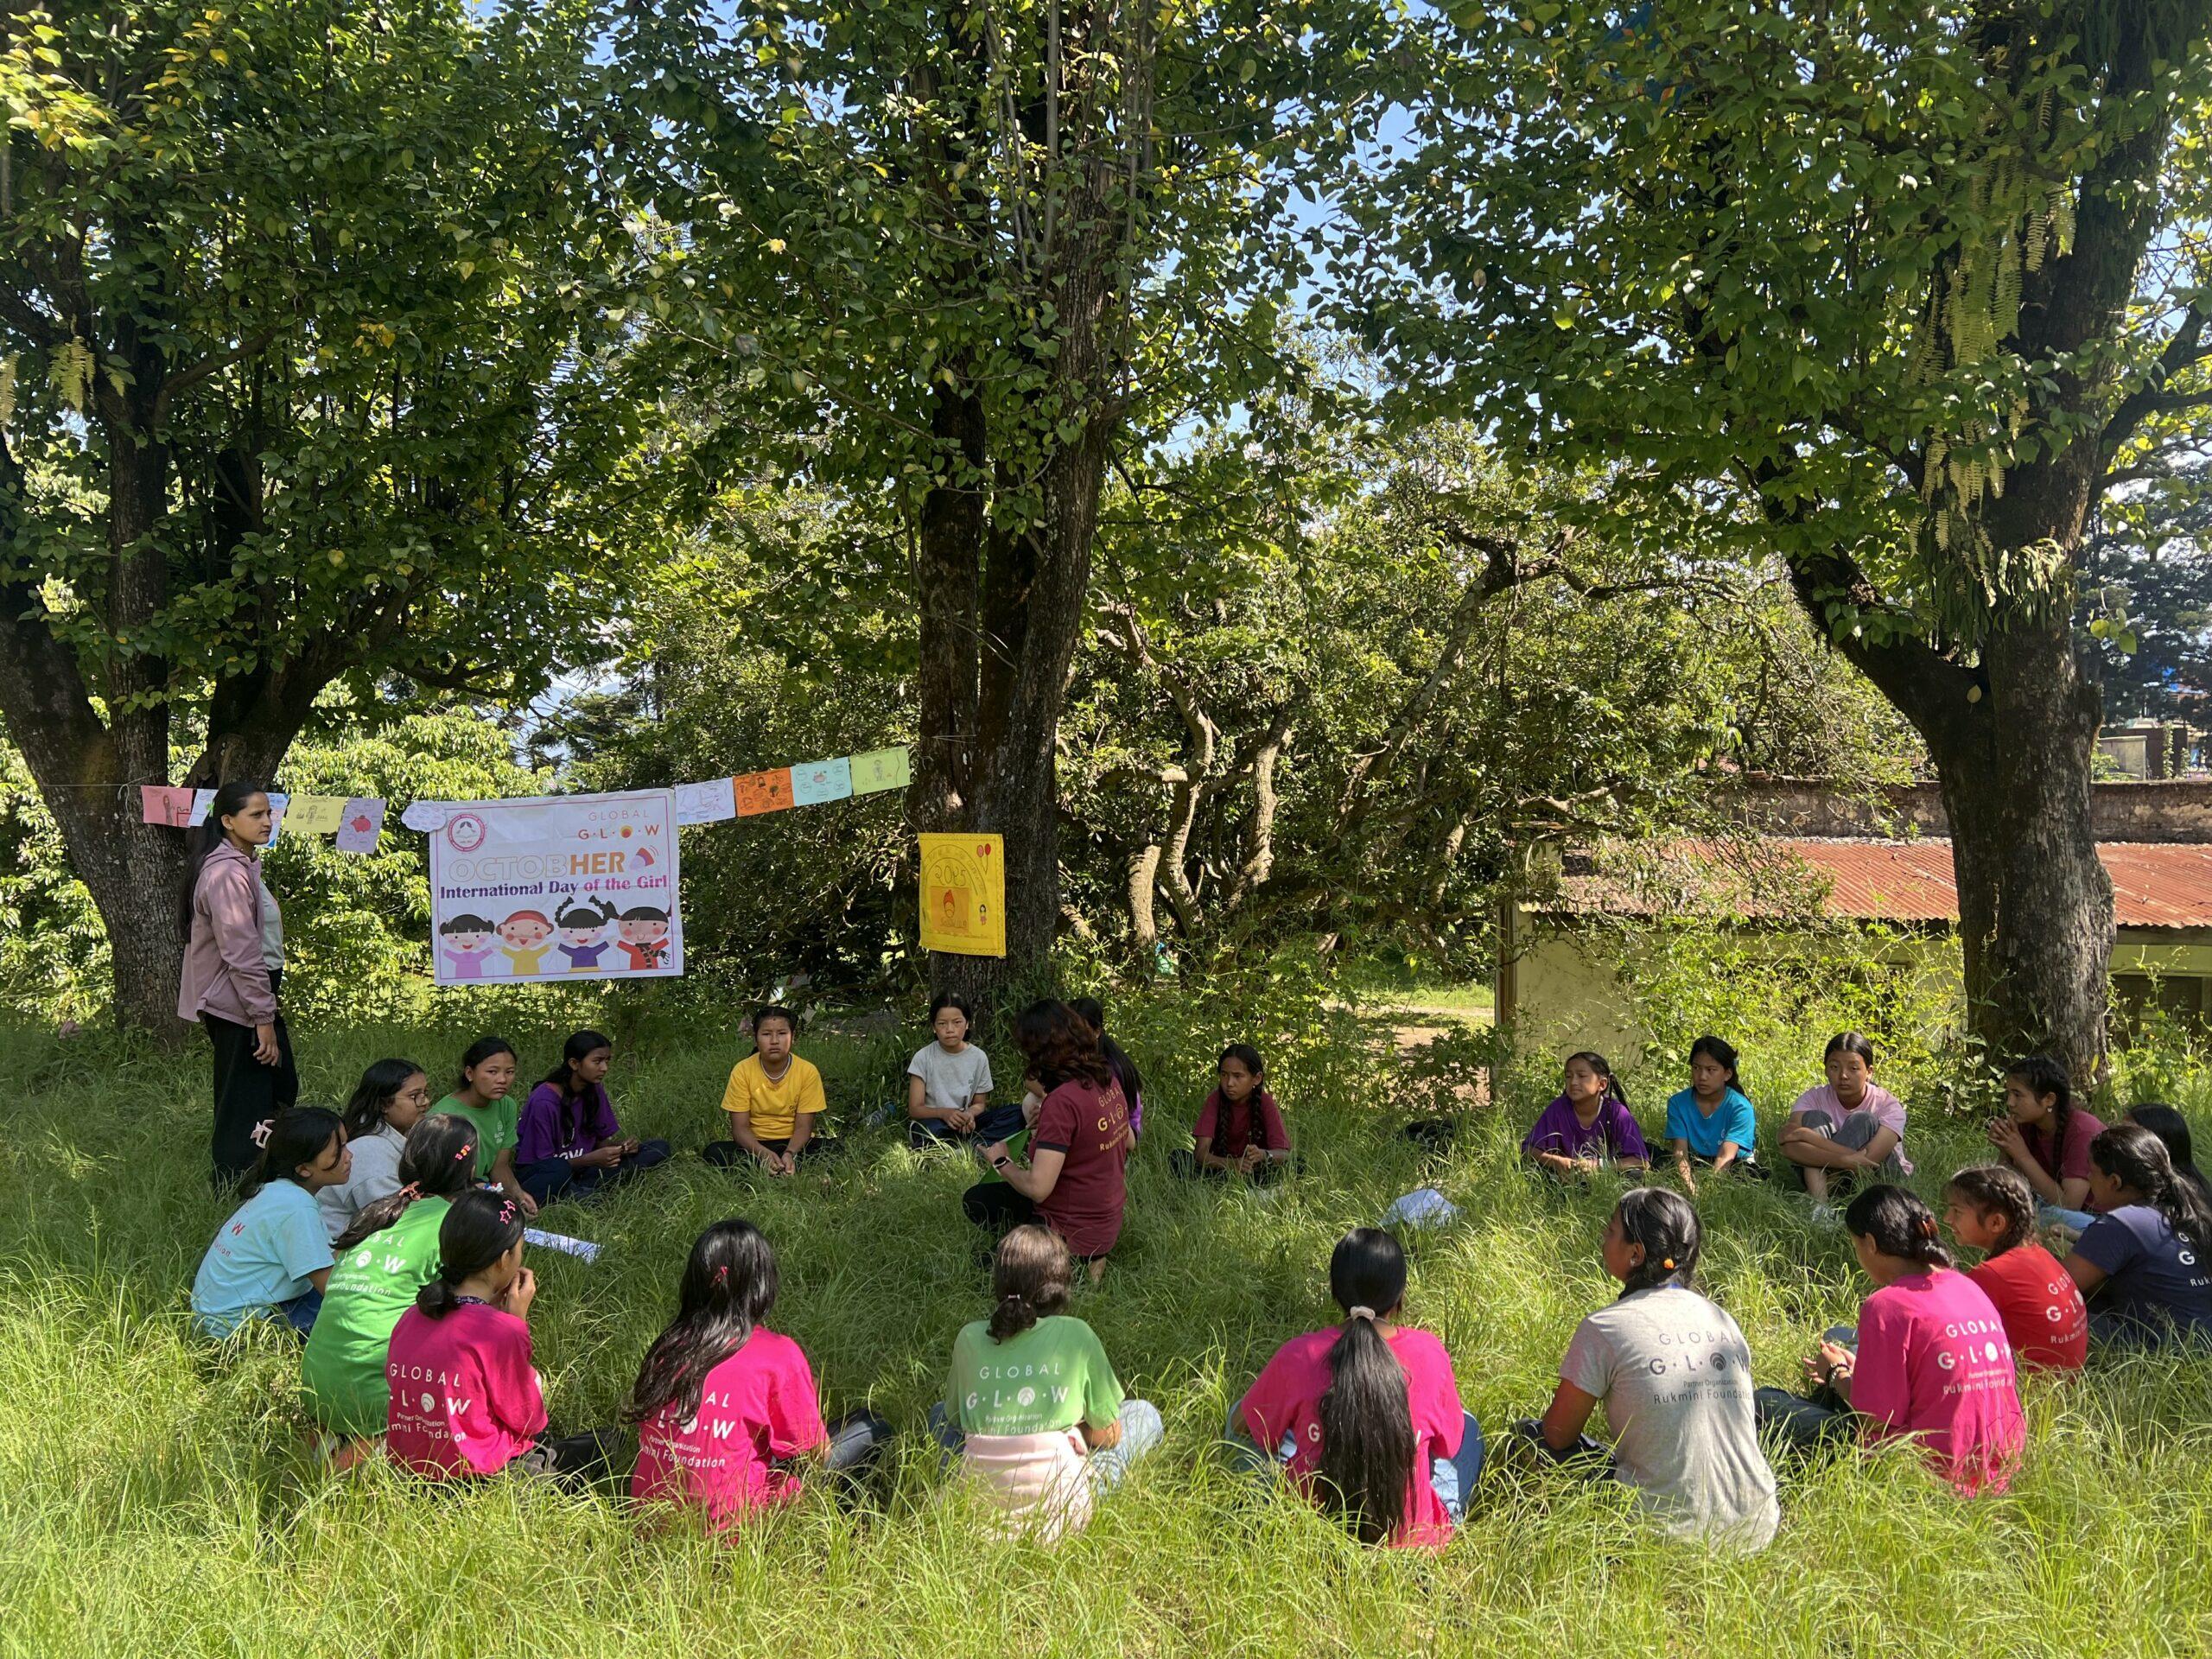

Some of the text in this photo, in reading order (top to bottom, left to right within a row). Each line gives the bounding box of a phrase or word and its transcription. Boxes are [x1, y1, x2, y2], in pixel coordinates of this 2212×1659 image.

[588, 810, 649, 822] GLOBAL
[440, 874, 667, 899] International Day of the Girl
[1659, 1331, 1737, 1345] GLOBAL
[390, 1363, 461, 1388] GLOBAL
[979, 1363, 1060, 1380] GLOBAL
[1653, 1389, 1703, 1404] Rukmini
